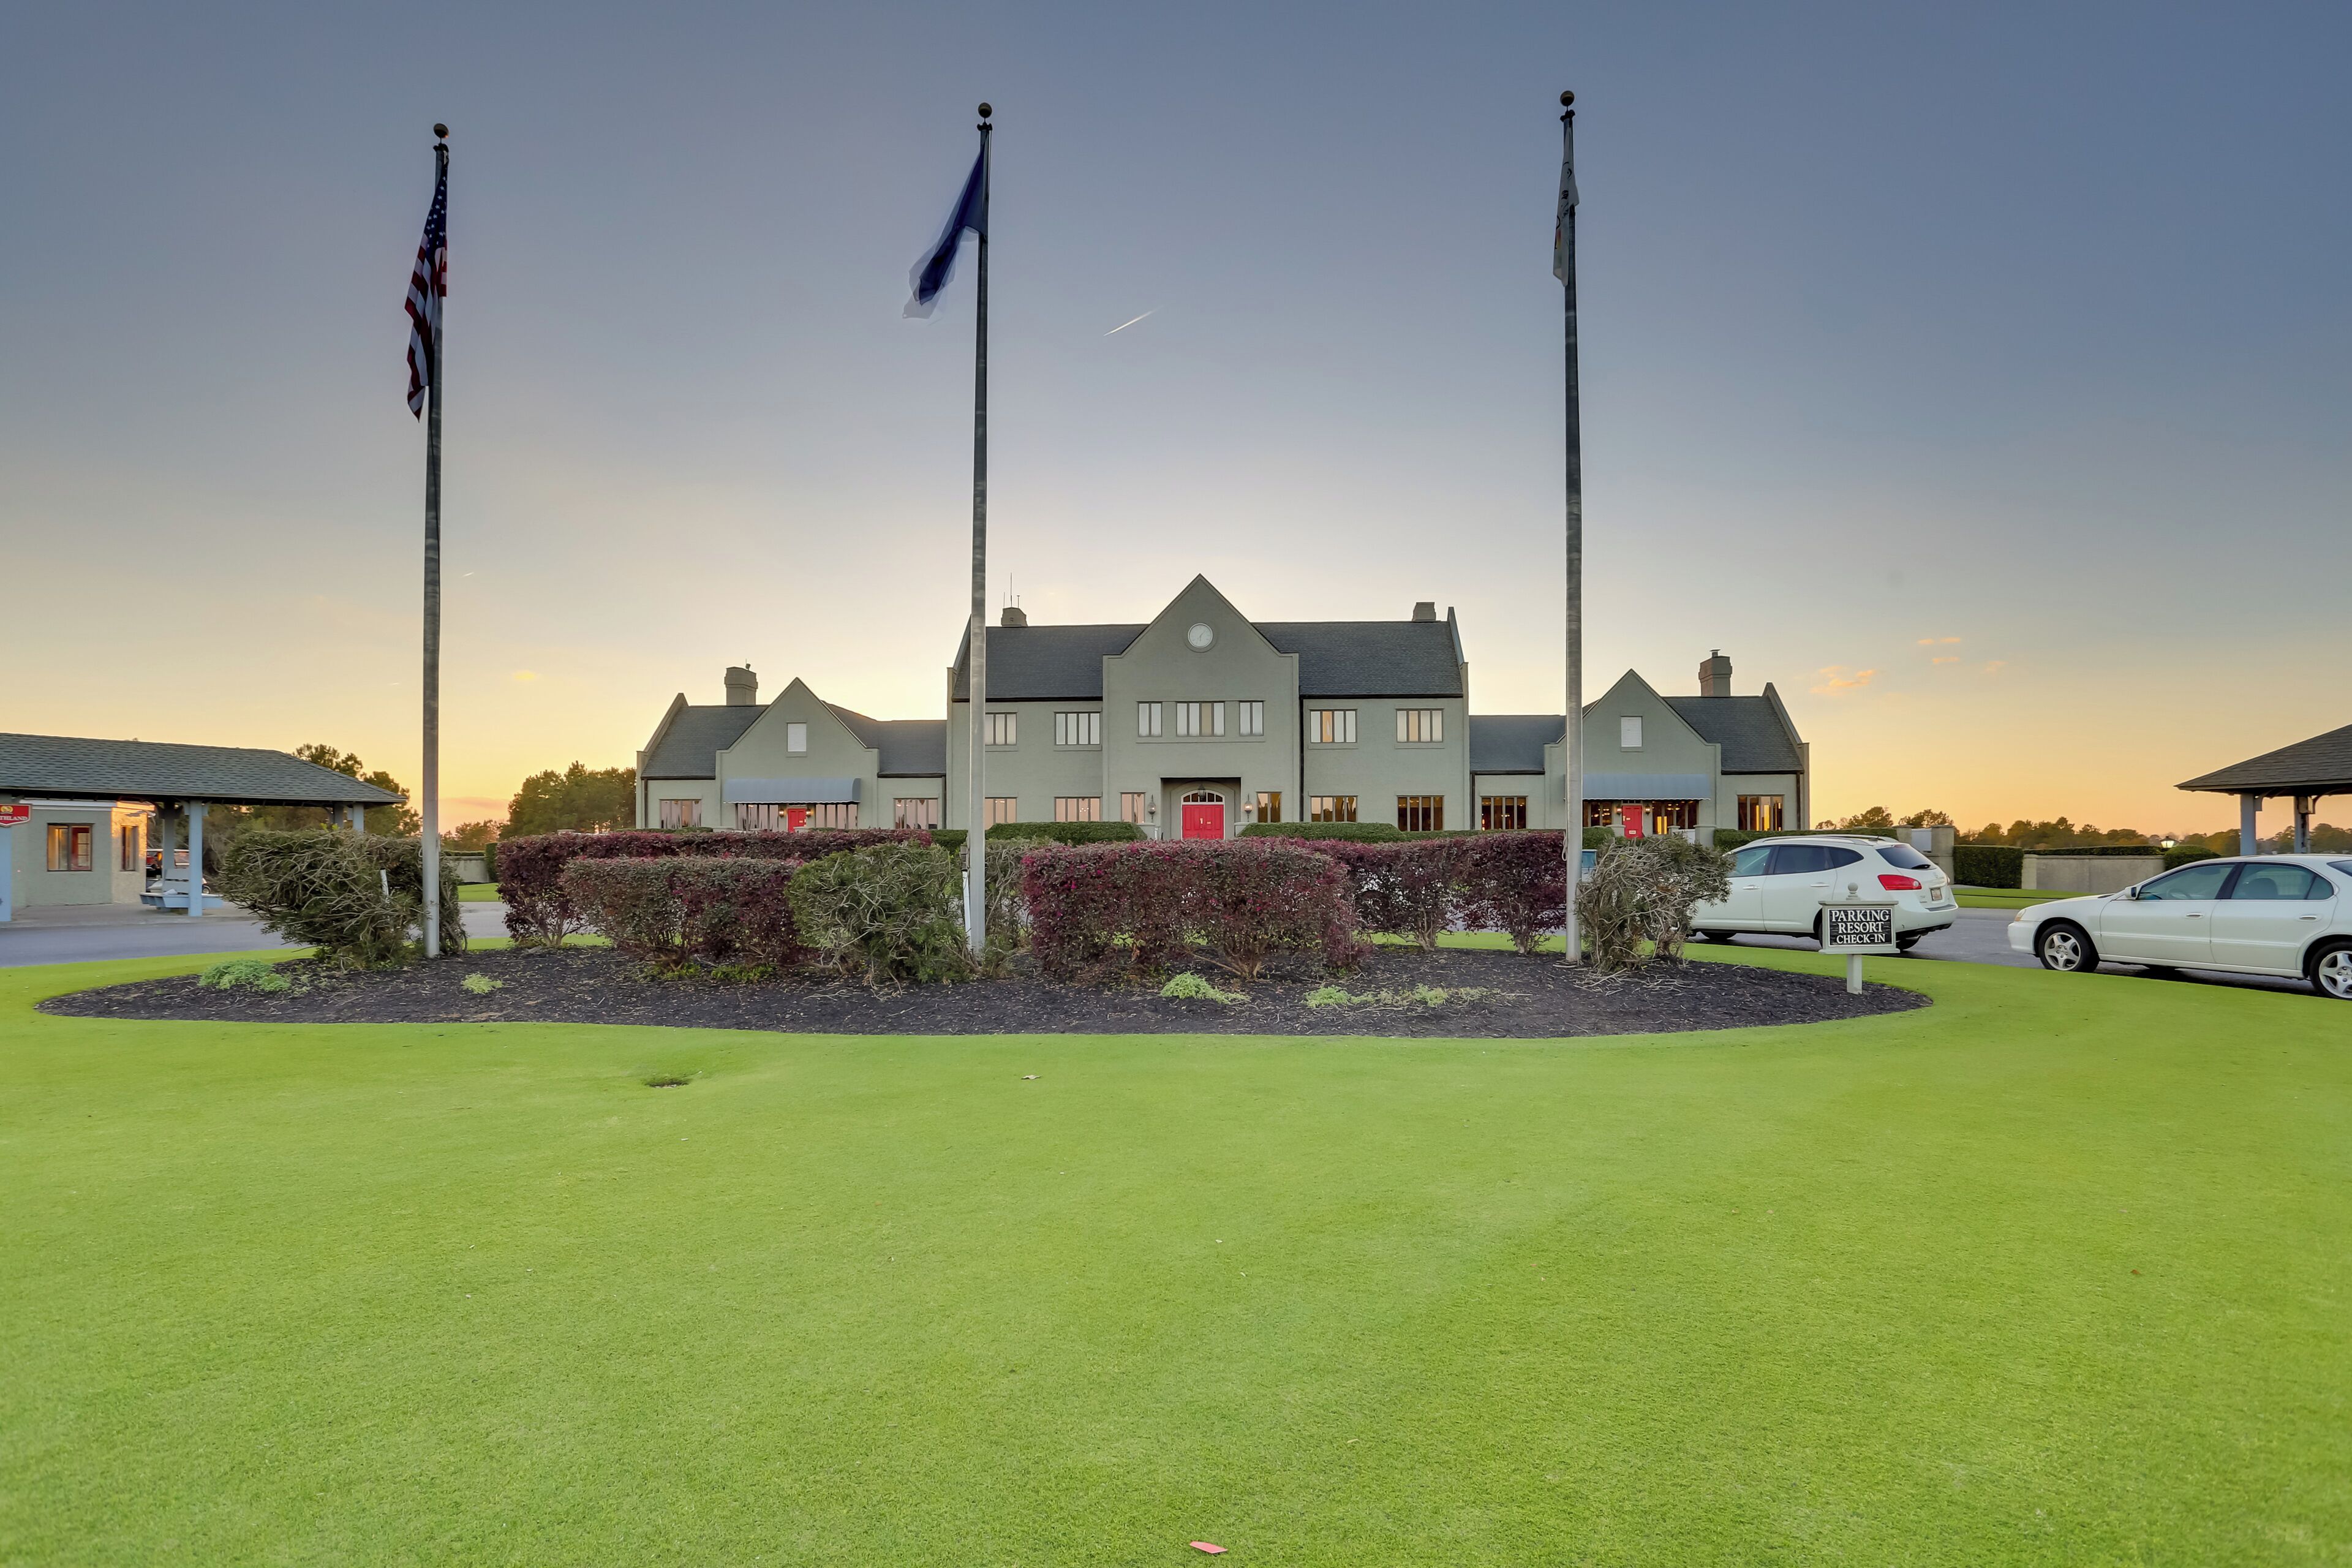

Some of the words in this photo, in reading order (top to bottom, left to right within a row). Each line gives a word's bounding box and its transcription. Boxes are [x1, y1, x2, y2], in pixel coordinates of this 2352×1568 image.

[1831, 910, 1889, 921] PARKING
[1838, 922, 1883, 933] RESORT
[1836, 934, 1885, 943] CHECK-IN
